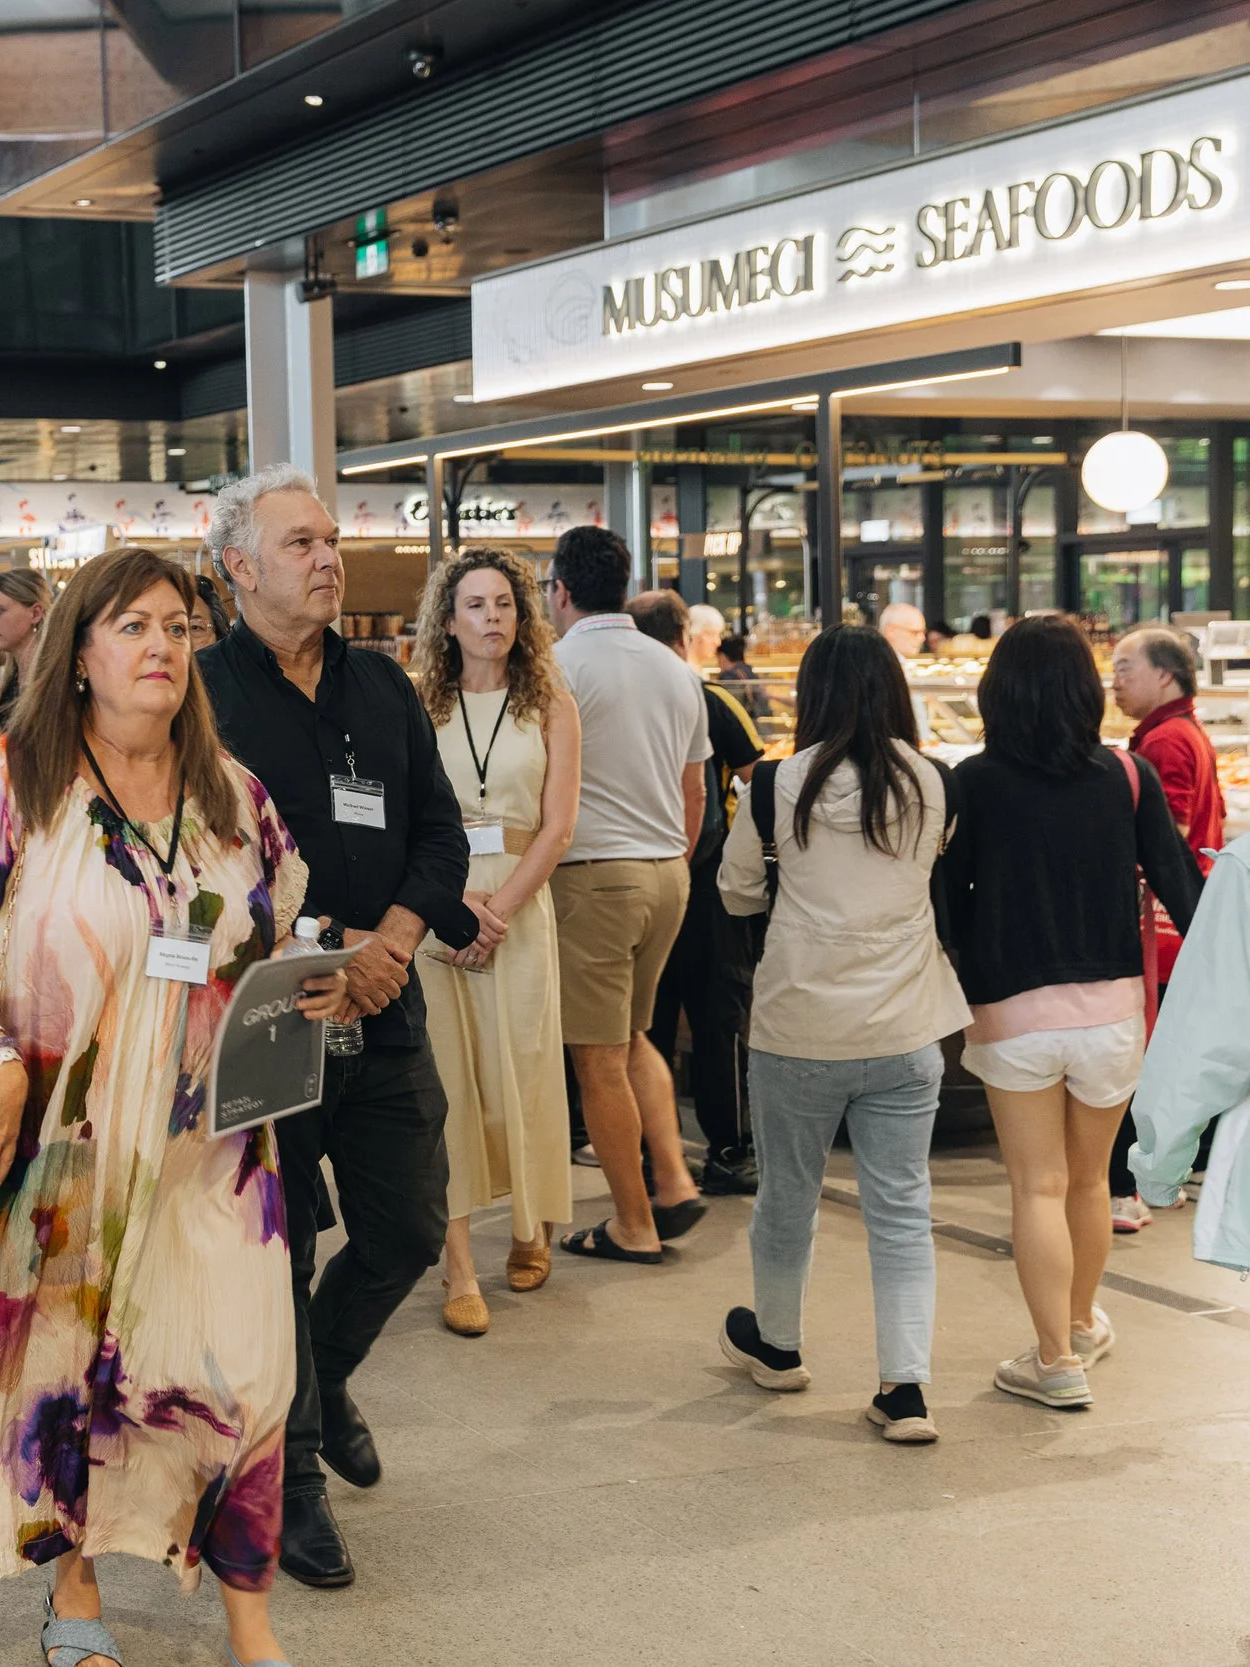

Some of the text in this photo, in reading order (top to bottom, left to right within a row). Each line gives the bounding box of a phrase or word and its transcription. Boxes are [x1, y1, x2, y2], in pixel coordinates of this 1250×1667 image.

[602, 136, 1223, 336] MUSUMECI SEAFOODS
[268, 1023, 277, 1043] 1
